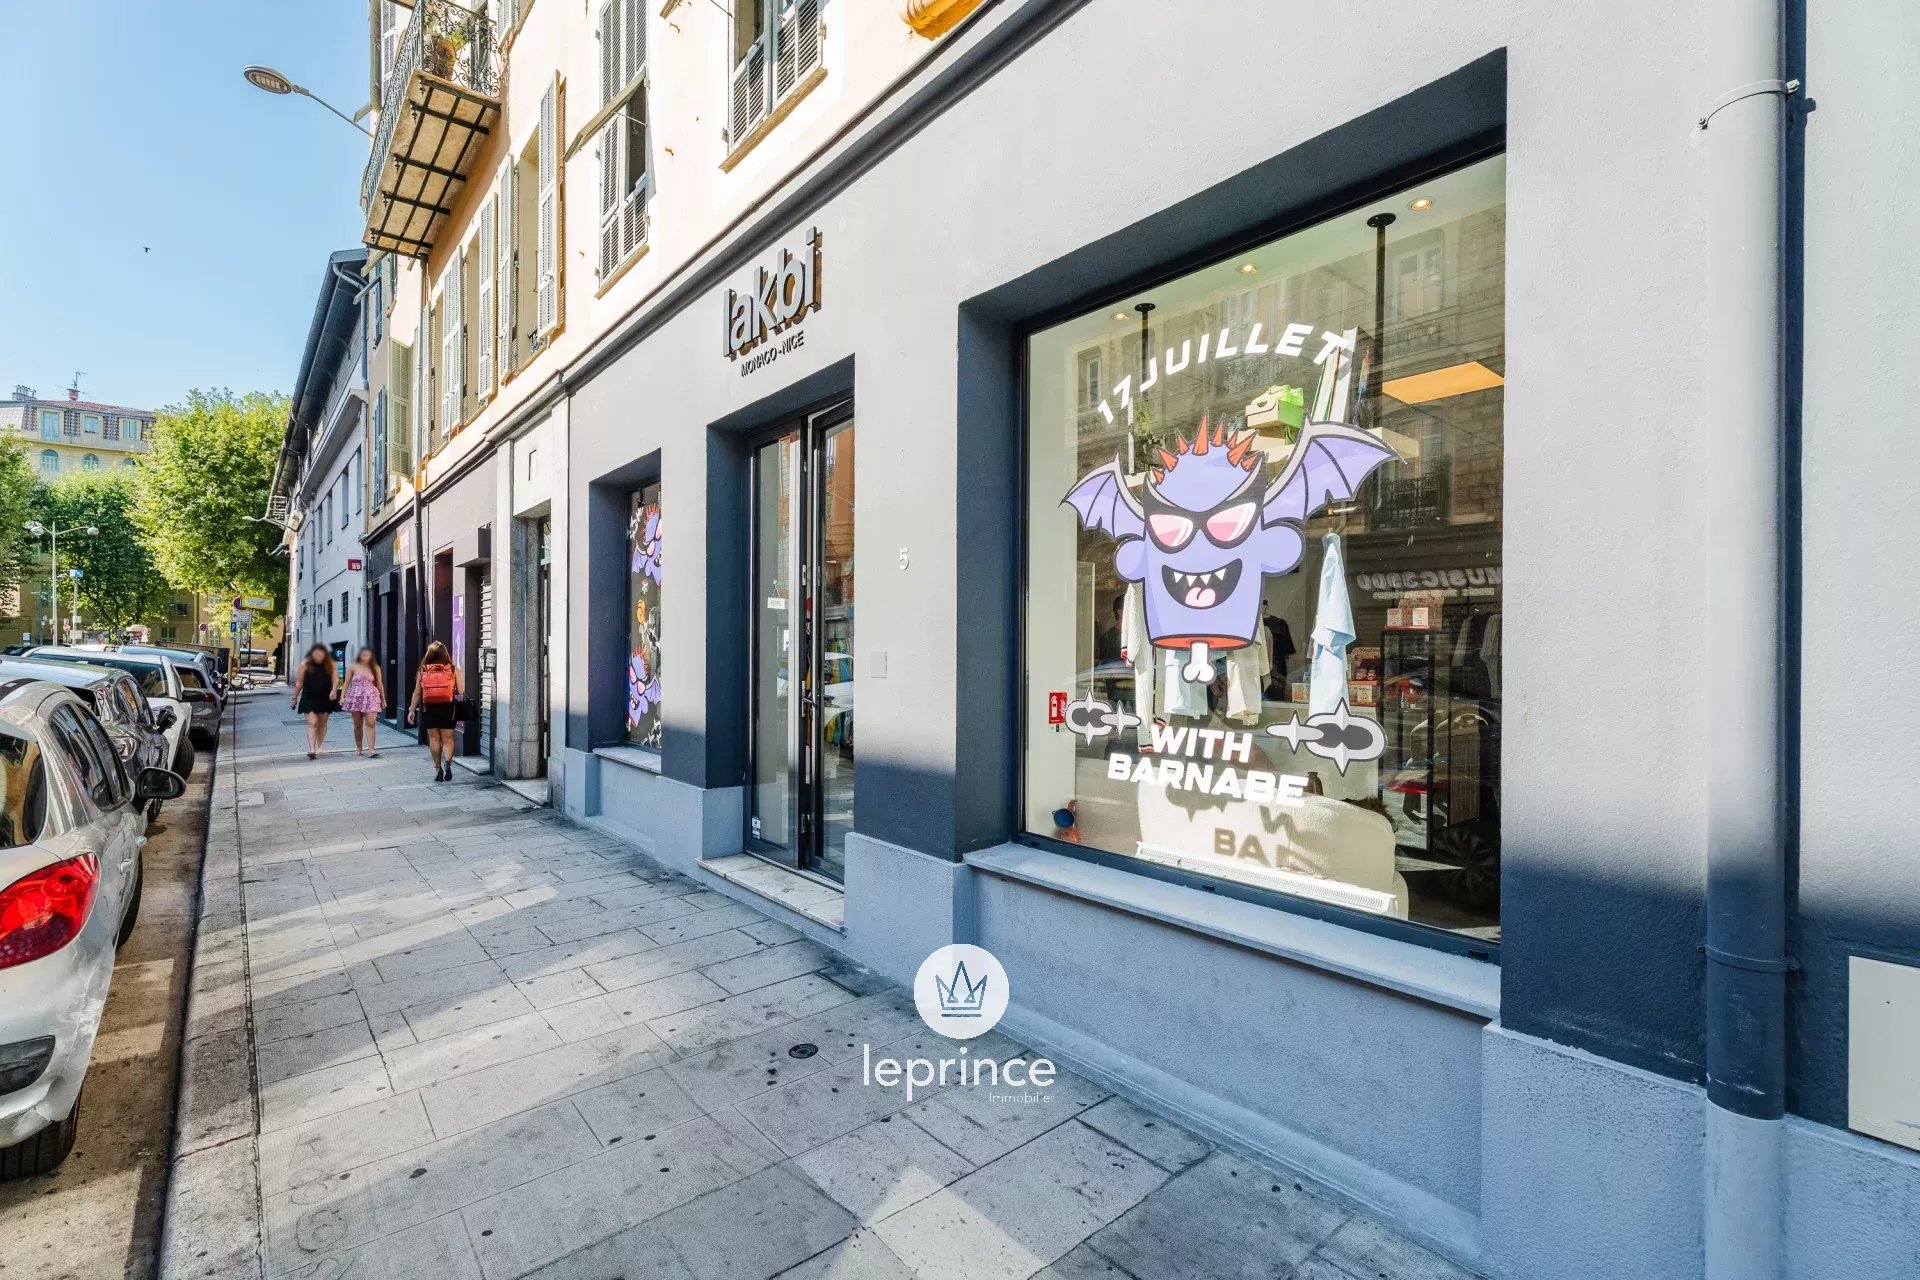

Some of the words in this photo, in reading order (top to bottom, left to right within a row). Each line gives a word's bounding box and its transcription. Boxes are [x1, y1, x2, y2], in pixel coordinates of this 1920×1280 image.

[723, 226, 822, 360] lakbi
[1138, 322, 1356, 393] JUILLET
[899, 547, 910, 571] 5
[1150, 724, 1253, 763] WITH
[1107, 752, 1310, 808] BARNABE
